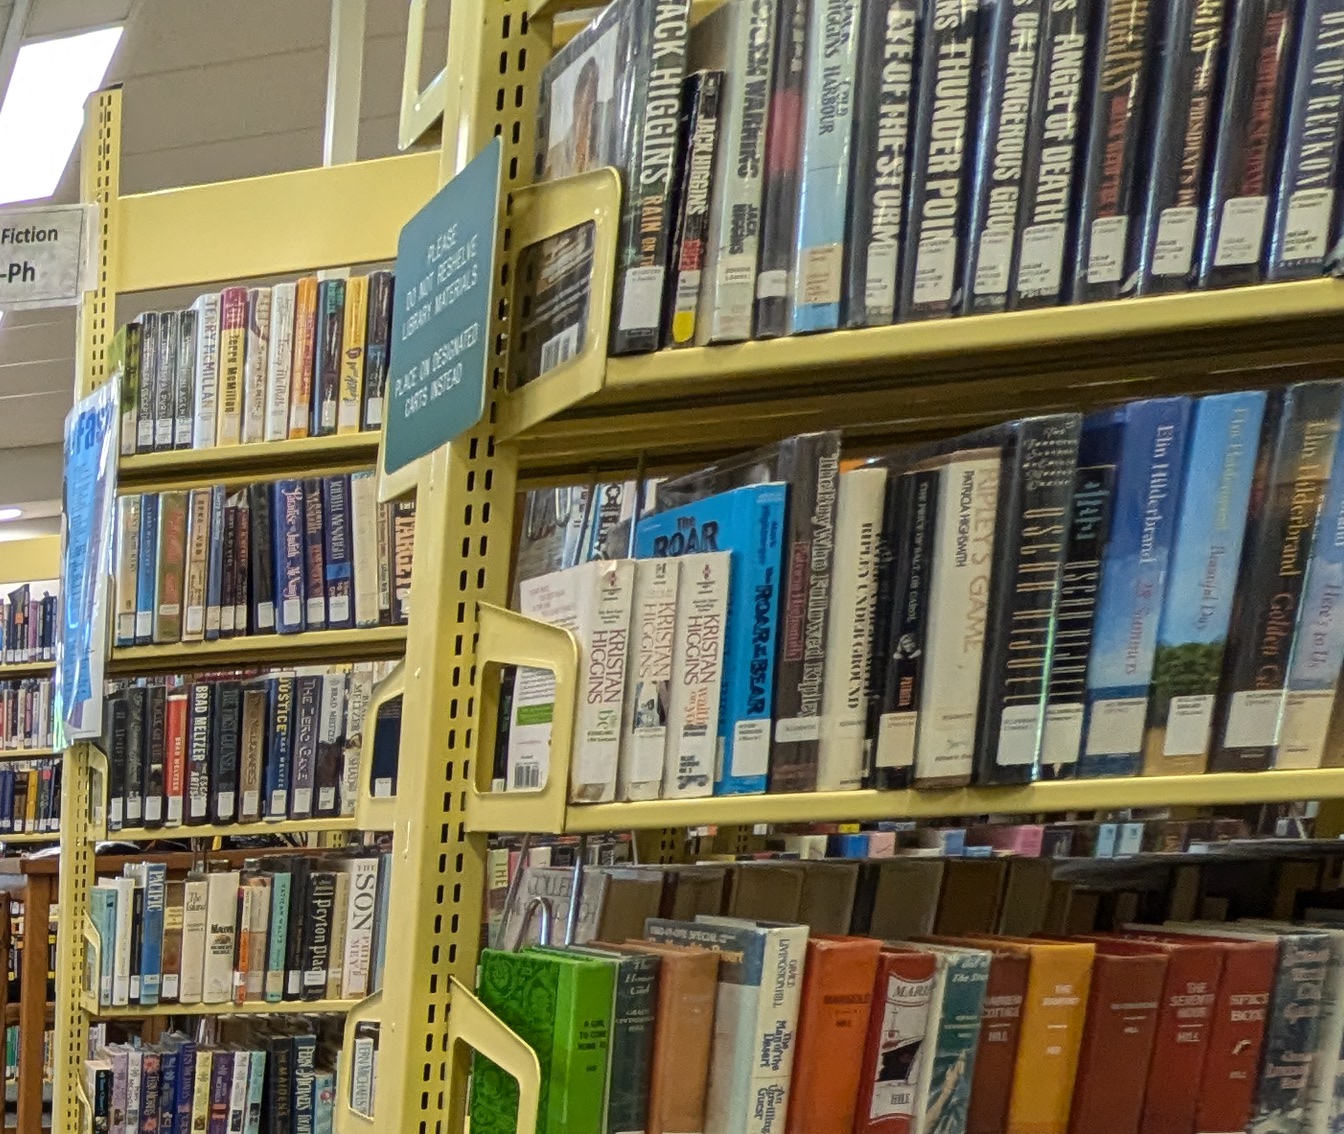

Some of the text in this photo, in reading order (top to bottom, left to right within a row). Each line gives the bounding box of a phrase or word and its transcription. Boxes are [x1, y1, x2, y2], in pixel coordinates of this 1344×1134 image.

[819, 65, 841, 136] HARBOUR
[872, 9, 914, 245] EYE THE STORM
[927, 38, 974, 173] THUNDER
[992, 53, 1036, 181] DANGEROUS
[1034, 33, 1086, 223] ANGEL DEATH
[640, 67, 684, 233] HIGGINS RAIN
[686, 116, 716, 215] JACK HIGGINS
[2, 226, 58, 245] Fiction
[427, 223, 458, 264] PLEASE
[402, 264, 478, 341] LIBRARY MATERIALS
[406, 233, 478, 311] DO NOT RESHELVE
[395, 322, 479, 398] PLACE ON DESIGNATED
[405, 362, 463, 418] CARTS INSTEAD
[677, 516, 695, 529] The
[1140, 424, 1175, 565] Elin Hilderbrand
[1280, 464, 1318, 578] Hilderbrand
[653, 521, 718, 556] ROAR
[956, 518, 971, 568] HIGHSMITH
[963, 467, 1000, 653] RIPLEY'S GAME
[587, 630, 608, 706] HIGGINS
[603, 628, 627, 704] KRISTAN
[639, 602, 657, 678] HIGGINS
[651, 602, 675, 681] KRISTAN
[683, 615, 702, 686] HIGGINS
[698, 613, 721, 684] KRISTAN
[191, 686, 208, 762] BRAD MELTZER
[277, 677, 294, 733] JUSTICE
[147, 870, 164, 912] PACIFIC
[352, 873, 375, 931] SON
[787, 960, 797, 987] GRACE
[760, 1033, 769, 1067] Desert
[783, 1031, 792, 1049] The
[1176, 1031, 1201, 1042] HILL
[755, 1087, 767, 1121] Guest
[761, 1084, 778, 1134] Unwilling
